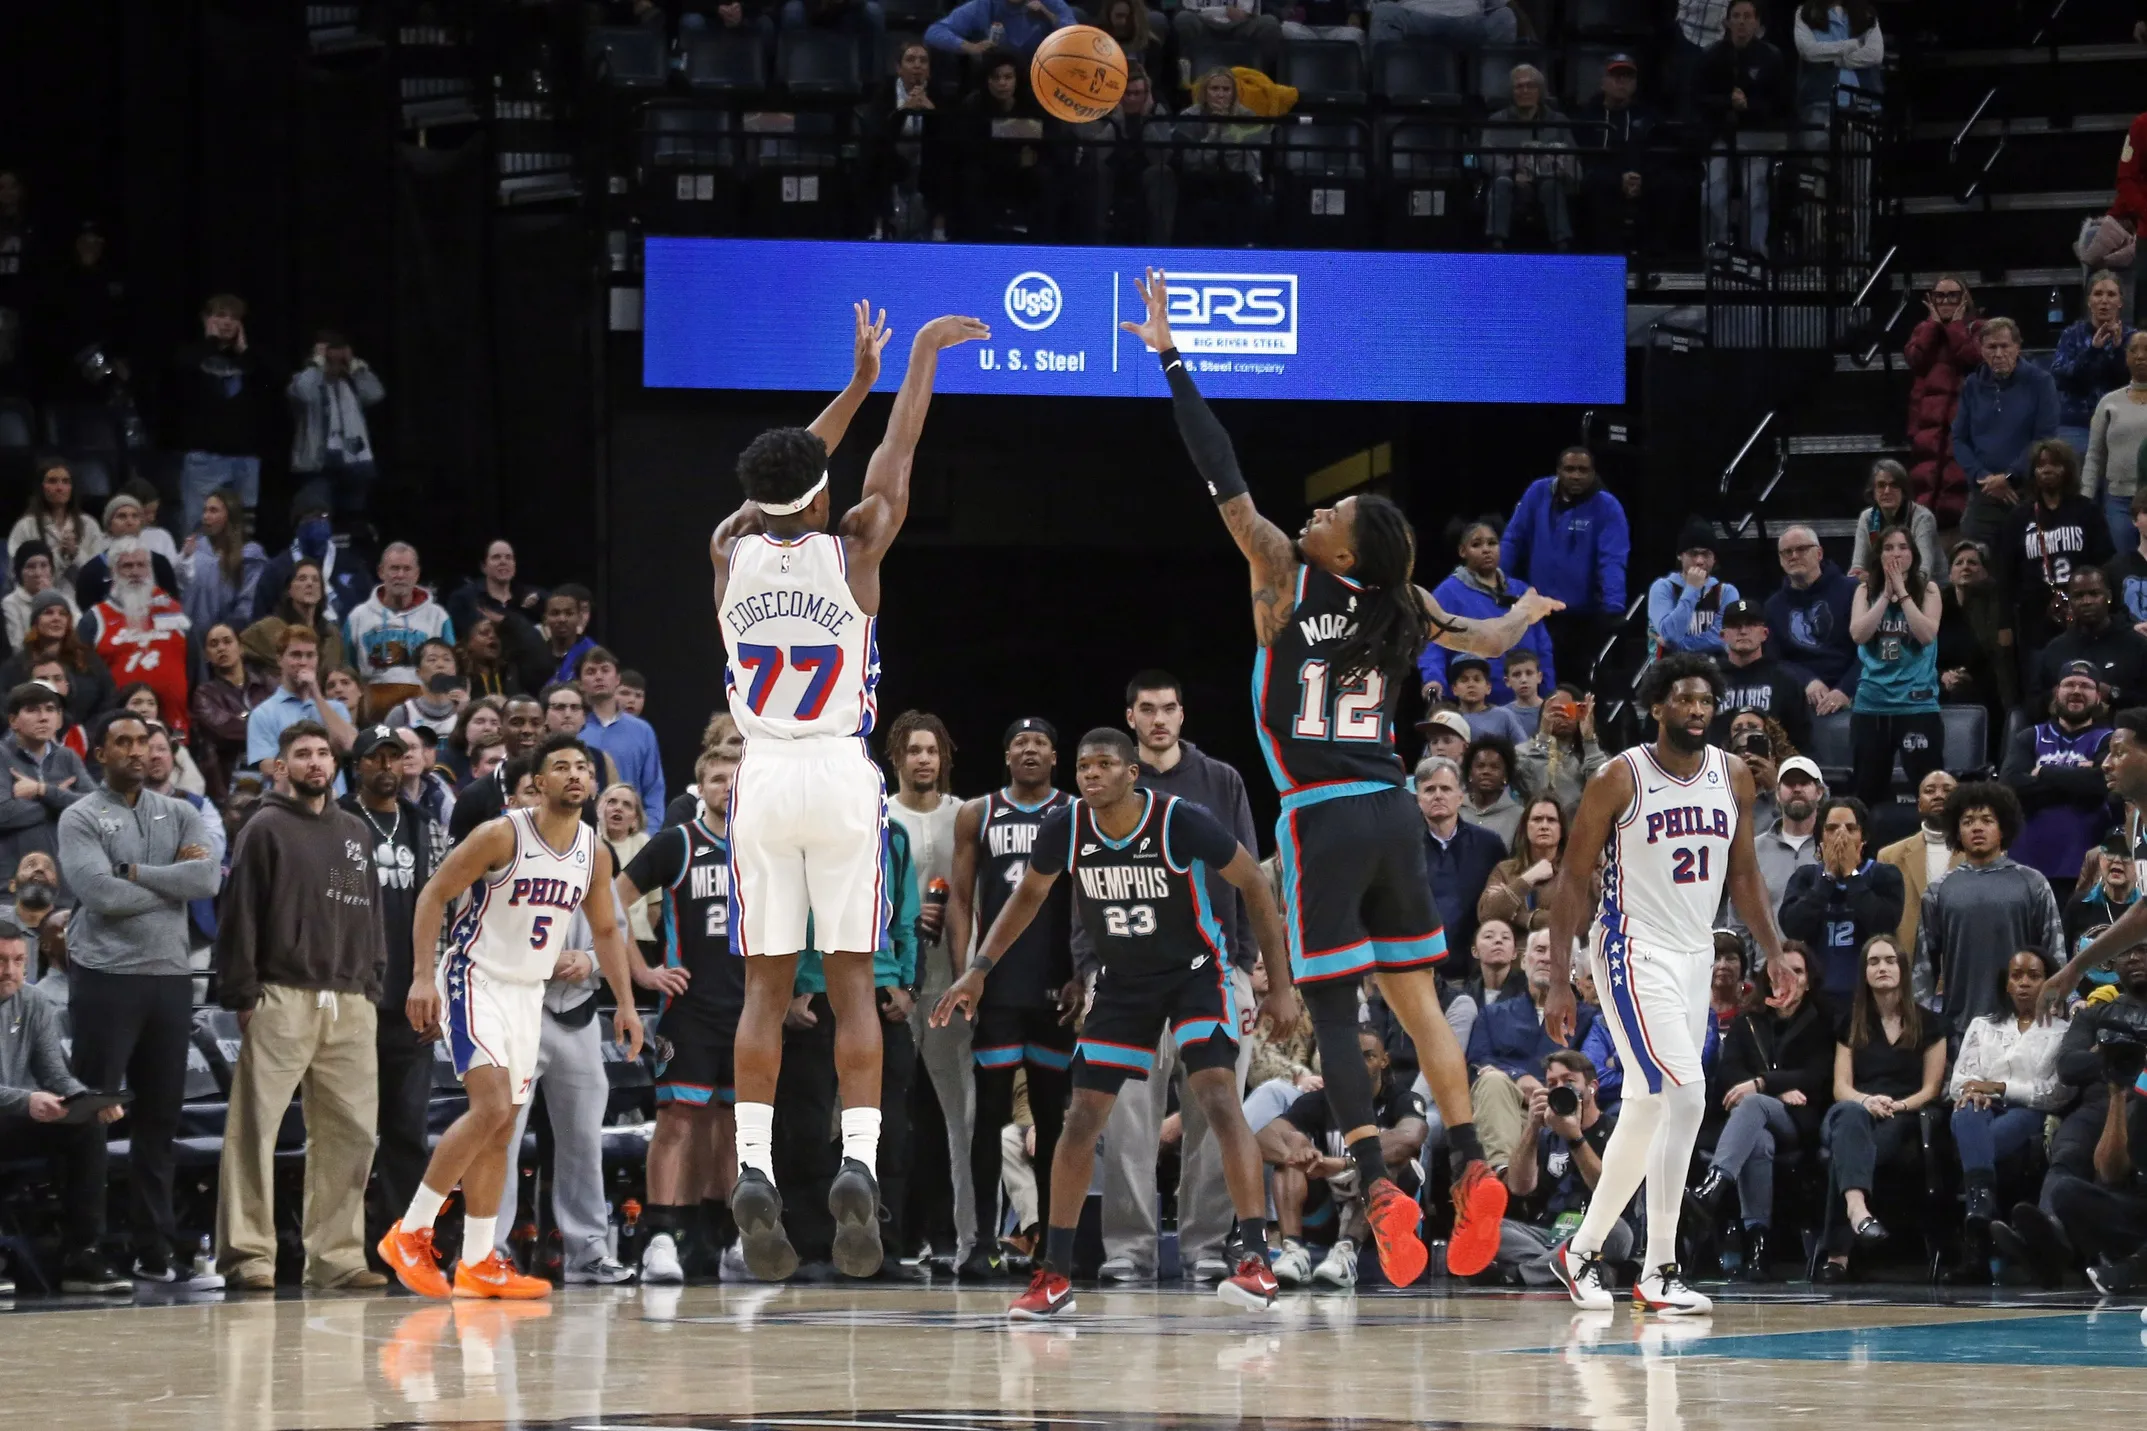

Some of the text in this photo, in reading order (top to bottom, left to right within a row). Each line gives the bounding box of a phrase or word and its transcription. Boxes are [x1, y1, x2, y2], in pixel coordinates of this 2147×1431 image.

[1012, 288, 1054, 317] USS
[1165, 286, 1286, 325] BRS
[979, 349, 1085, 372] U. S. Steel
[1253, 338, 1285, 348] STEEL
[1200, 360, 1232, 372] Steel
[1234, 361, 1285, 374] company
[727, 590, 853, 637] EDGECOMBE
[737, 641, 844, 721] 77
[1292, 658, 1388, 744] 12
[1646, 806, 1729, 844] PHILA
[1672, 845, 1709, 884] 21
[1078, 866, 1169, 900] MEMPHIS
[529, 915, 553, 951] 5
[1103, 904, 1158, 938] 23
[1826, 921, 1855, 947] 12
